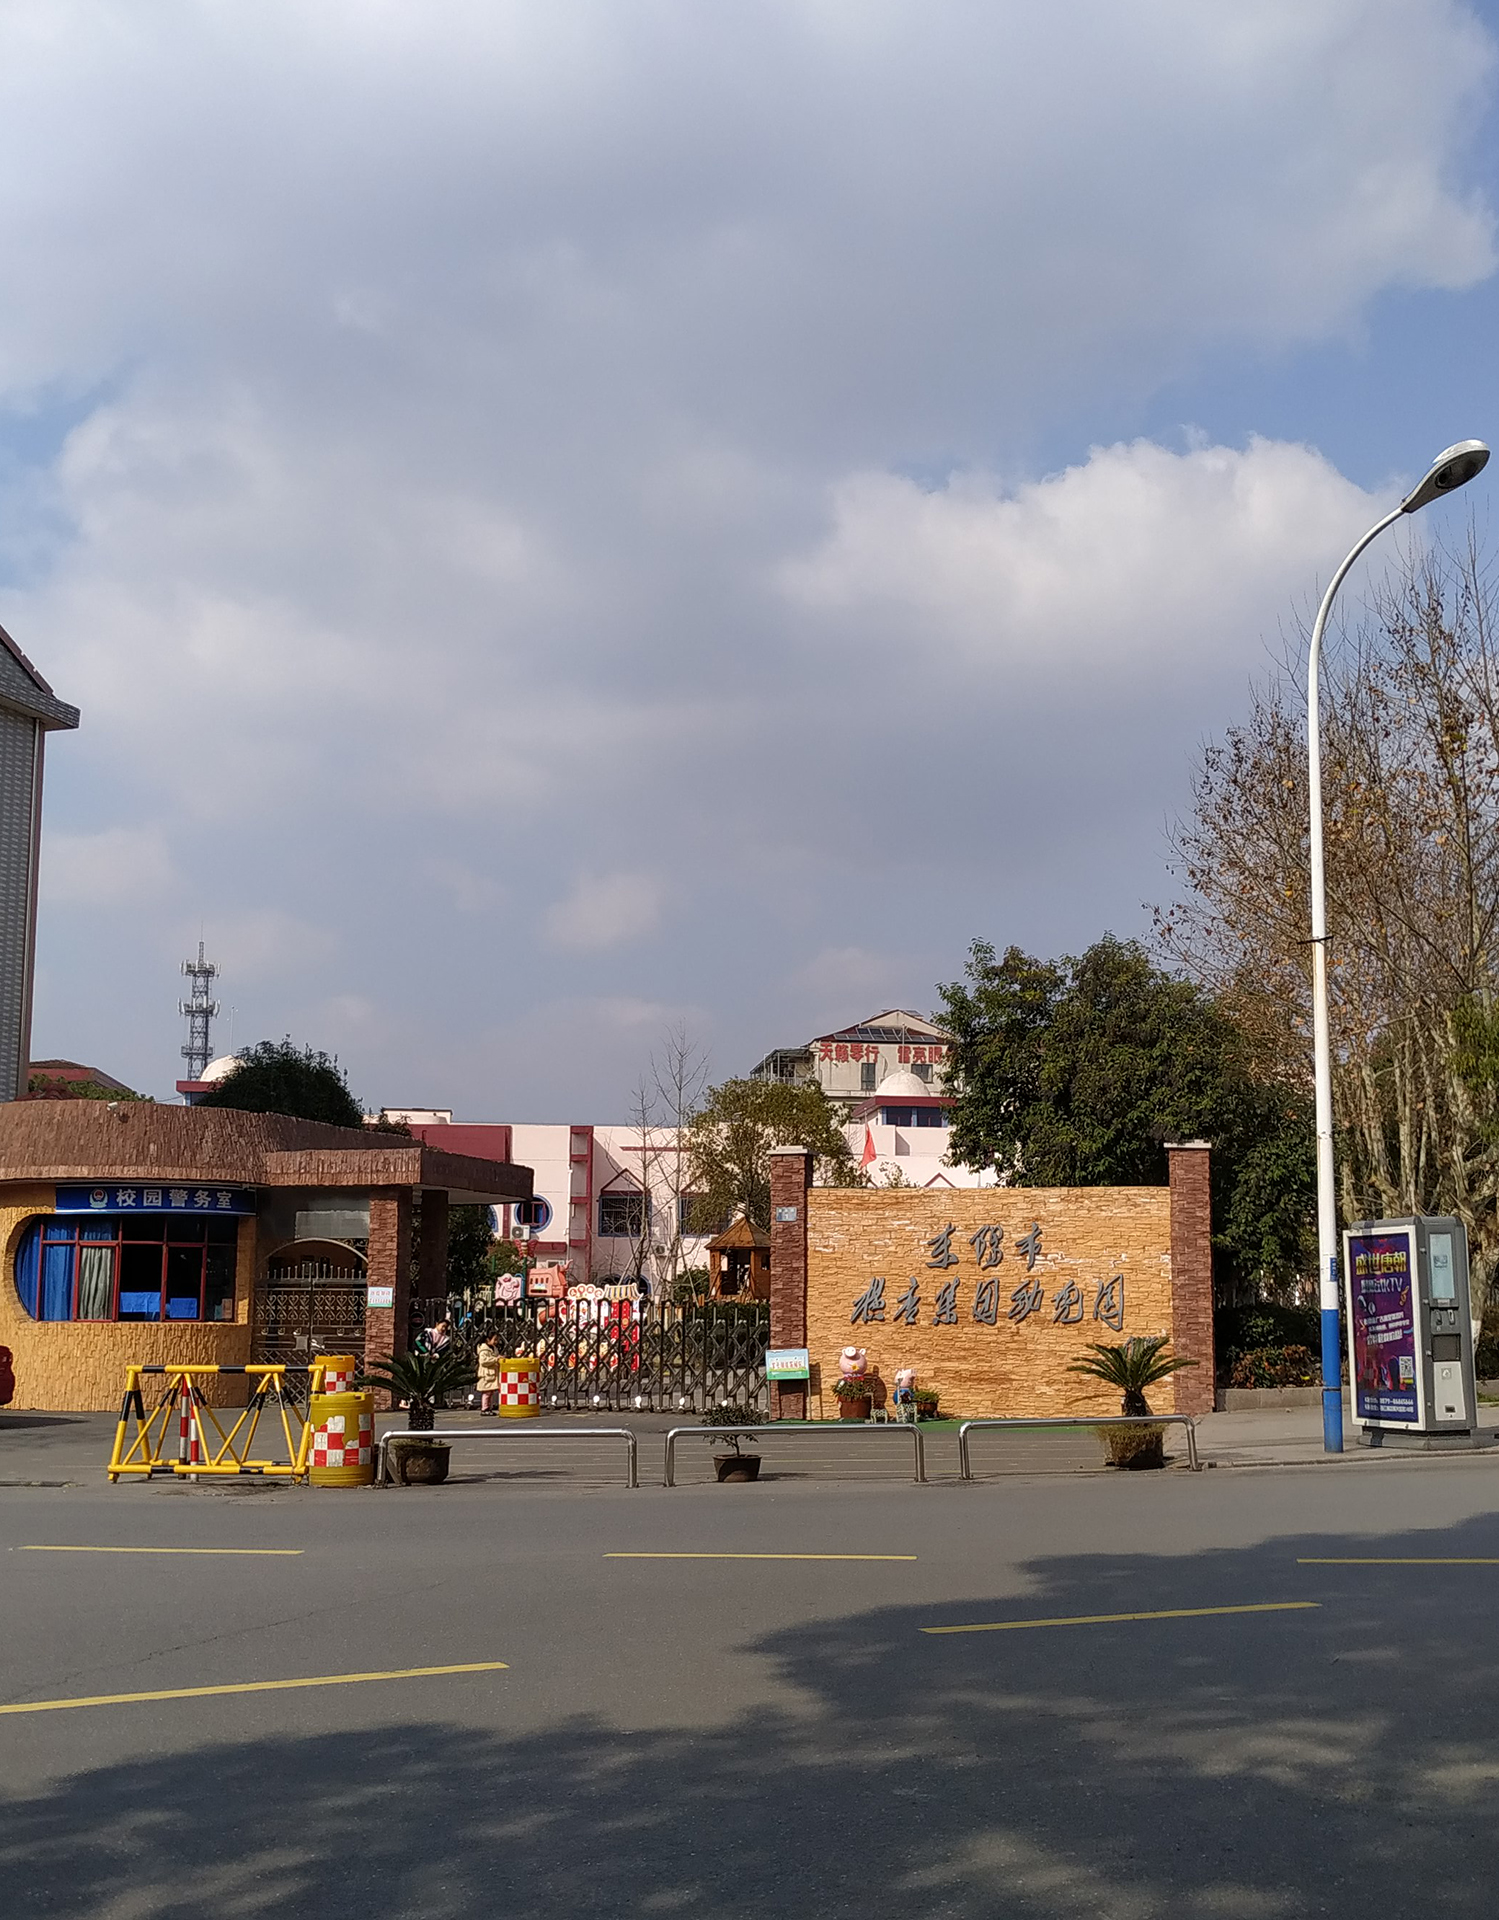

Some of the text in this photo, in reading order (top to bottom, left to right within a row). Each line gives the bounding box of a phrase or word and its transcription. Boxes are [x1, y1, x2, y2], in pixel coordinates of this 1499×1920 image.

[819, 1043, 880, 1063] 天籁琴行
[116, 1188, 232, 1209] 校园警务室
[1355, 1251, 1407, 1276] 盛世唐朝
